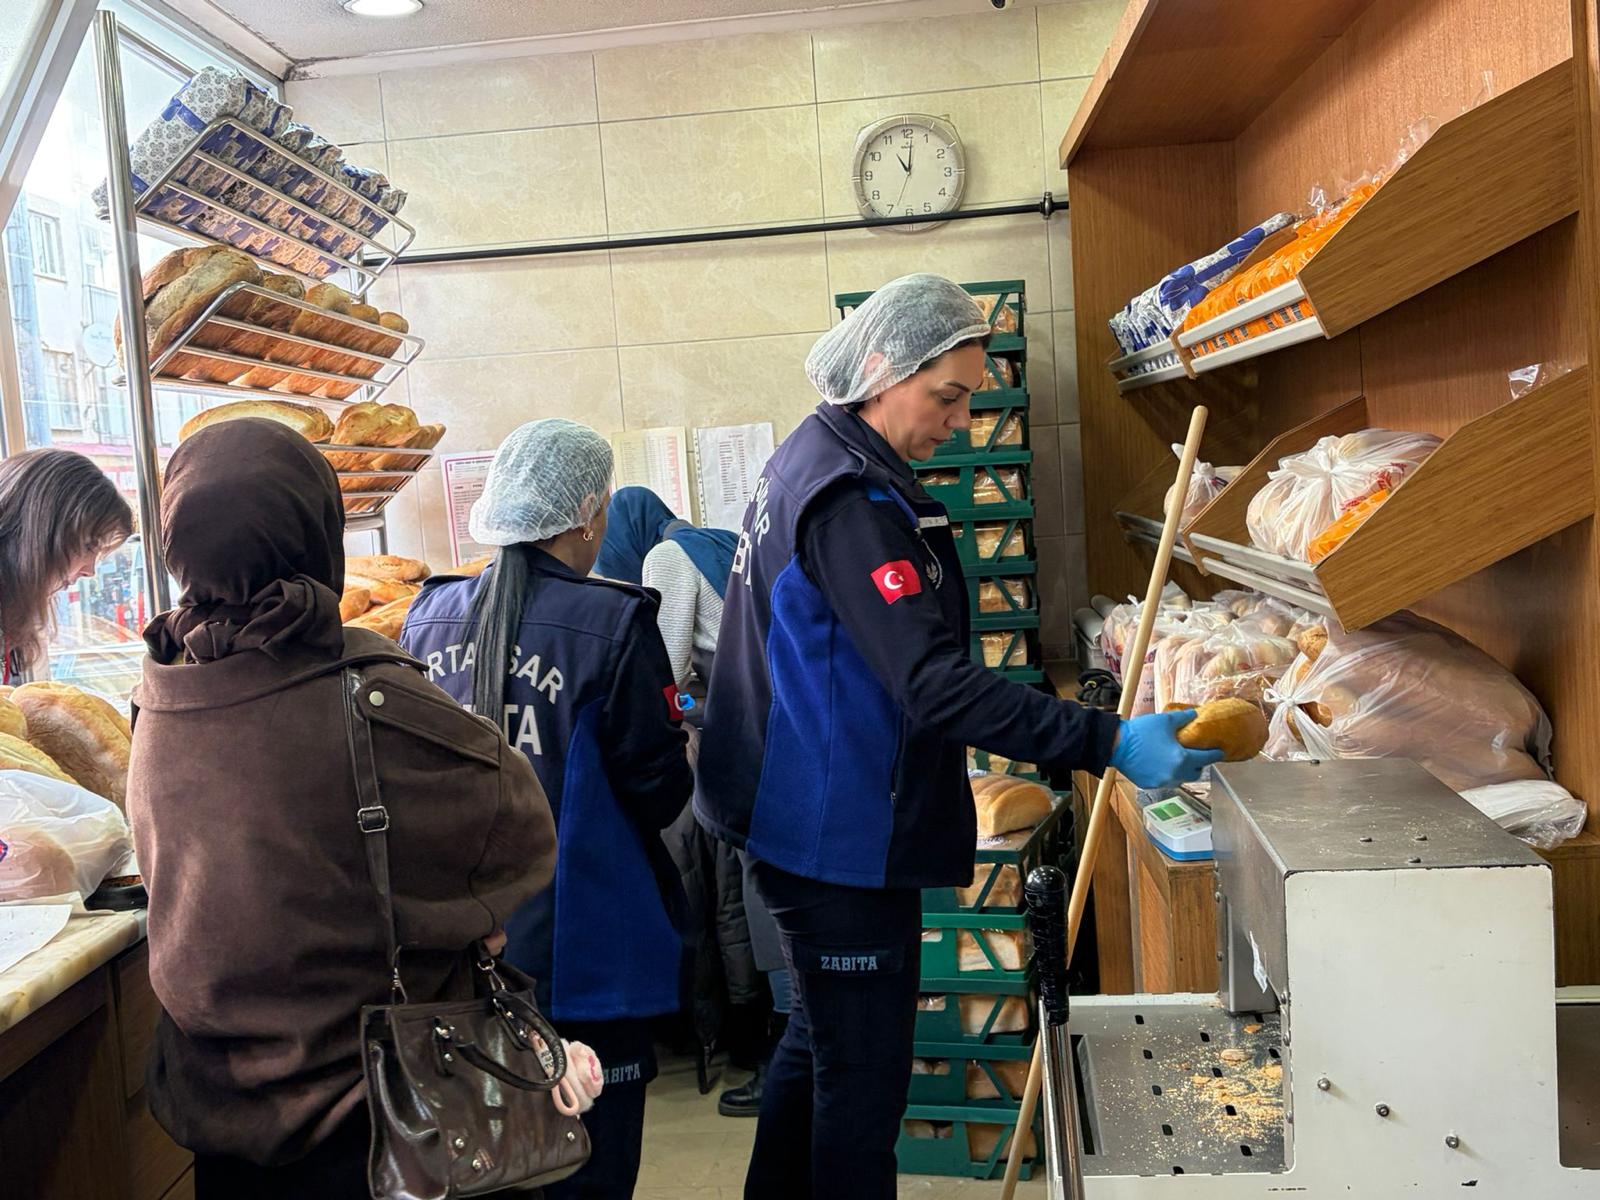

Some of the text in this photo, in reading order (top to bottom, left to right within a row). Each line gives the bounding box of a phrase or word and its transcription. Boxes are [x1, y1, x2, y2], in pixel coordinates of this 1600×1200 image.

[901, 128, 913, 139] 12
[923, 133, 929, 143] 1
[883, 135, 893, 145] 11
[869, 151, 881, 162] 10
[936, 148, 945, 159] 2
[864, 170, 873, 181] 9
[943, 167, 952, 177] 3
[872, 190, 880, 200] 8
[938, 187, 946, 197] 4
[886, 204, 894, 214] 7
[923, 202, 932, 213] 5
[820, 955, 879, 971] ZABITA
[603, 1063, 641, 1084] ABITA
